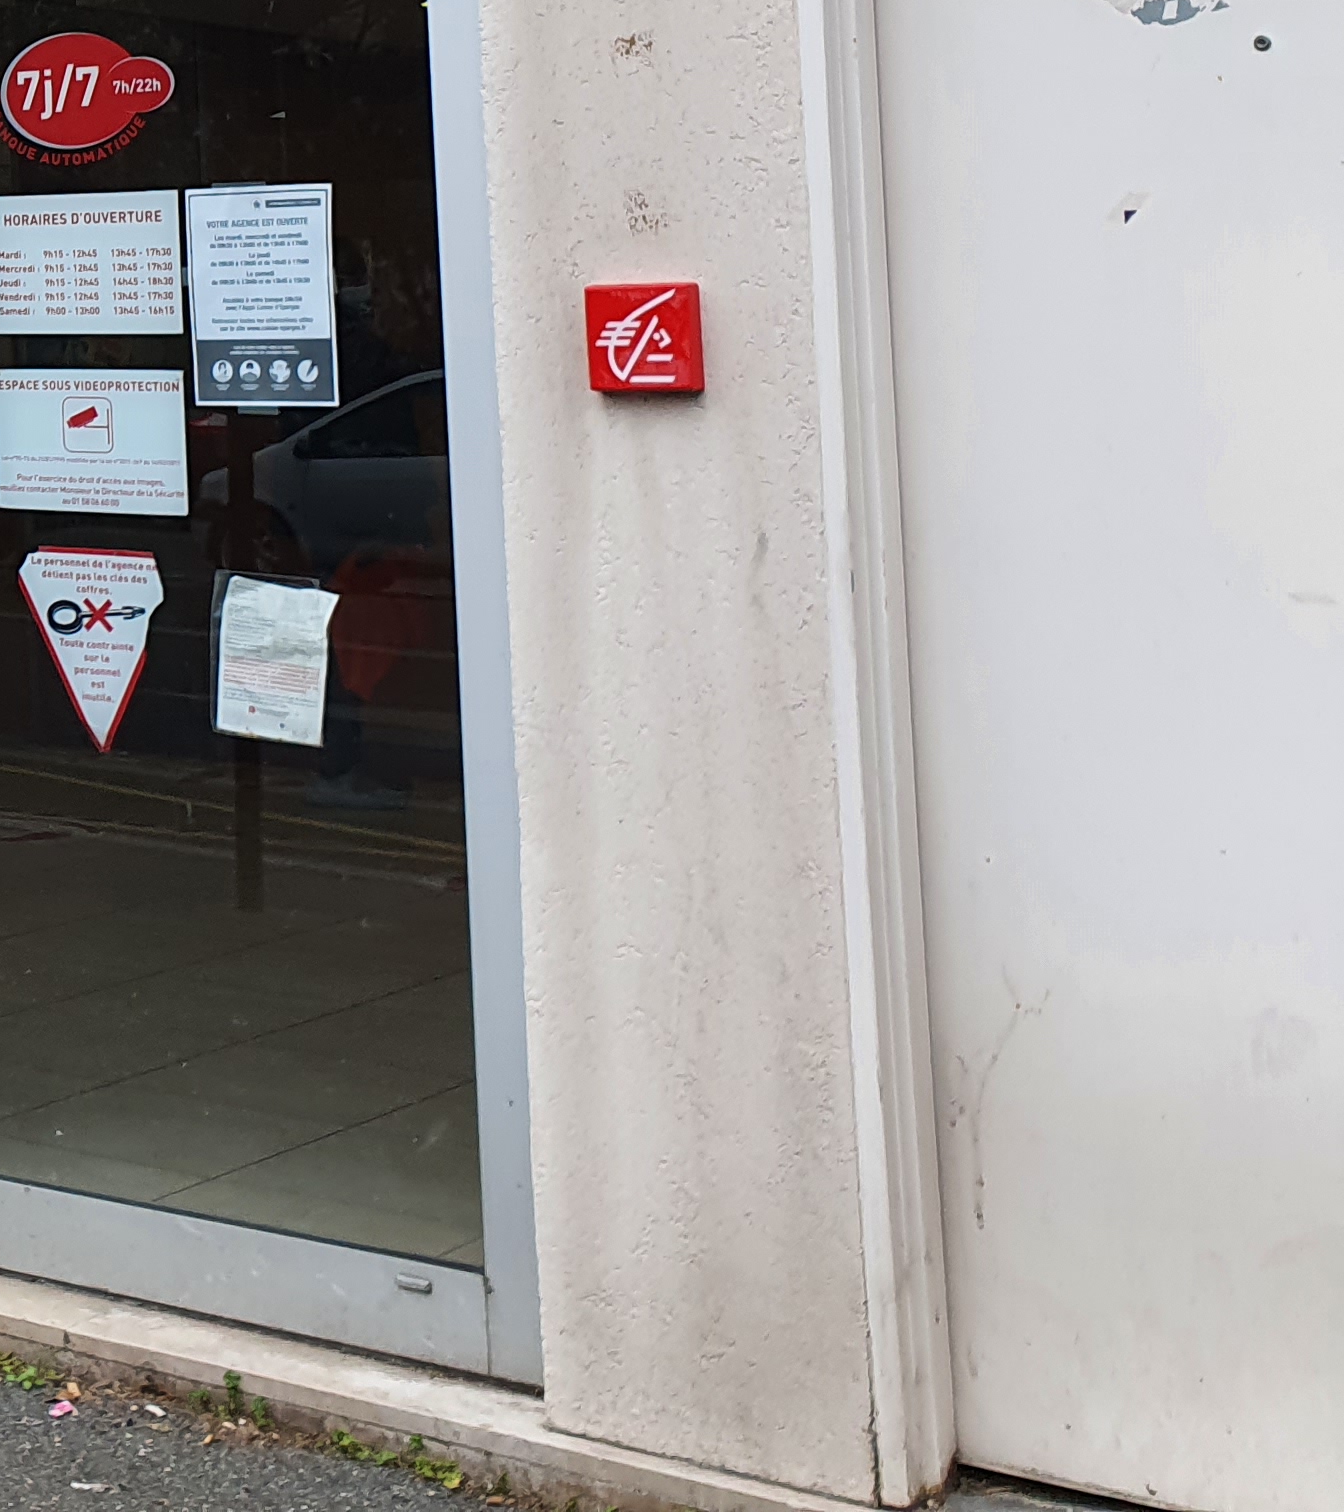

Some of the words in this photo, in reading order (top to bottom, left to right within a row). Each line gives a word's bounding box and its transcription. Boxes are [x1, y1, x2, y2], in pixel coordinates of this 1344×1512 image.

[17, 63, 100, 120] 7j/7
[112, 78, 162, 95] 7h/22h
[40, 116, 147, 166] AUTOMATIQUE
[3, 213, 67, 227] HORAIRES
[71, 210, 163, 225] D'OUVERTURE
[43, 250, 64, 259] 9h15
[72, 249, 98, 258] 12h45
[110, 248, 137, 257] 13h45
[146, 248, 172, 257] 17h30
[44, 264, 65, 273] 9h15
[73, 263, 99, 273] 12h45
[147, 262, 173, 271] 17h30
[0, 278, 21, 287] Jeudi
[45, 279, 65, 288] 9h15
[74, 278, 99, 287] 12h45
[0, 293, 36, 302] Vendredi
[45, 292, 65, 302] 9h15
[74, 292, 99, 301] 12h45
[147, 291, 174, 300] 17h30
[0, 307, 30, 316] Samedi
[41, 380, 71, 391] SOUS
[73, 380, 180, 393] VIDEOPROTECTION
[31, 557, 43, 565] Le
[44, 557, 90, 568] personnel
[92, 560, 103, 569] de
[105, 560, 144, 572] l'agence
[75, 572, 92, 582] pas
[93, 572, 108, 582] les
[109, 573, 129, 583] clés
[131, 576, 148, 584] des
[59, 638, 84, 649] Toute
[84, 654, 98, 663] sur
[101, 654, 110, 663] le
[74, 667, 121, 677] personnel
[91, 680, 105, 689] est
